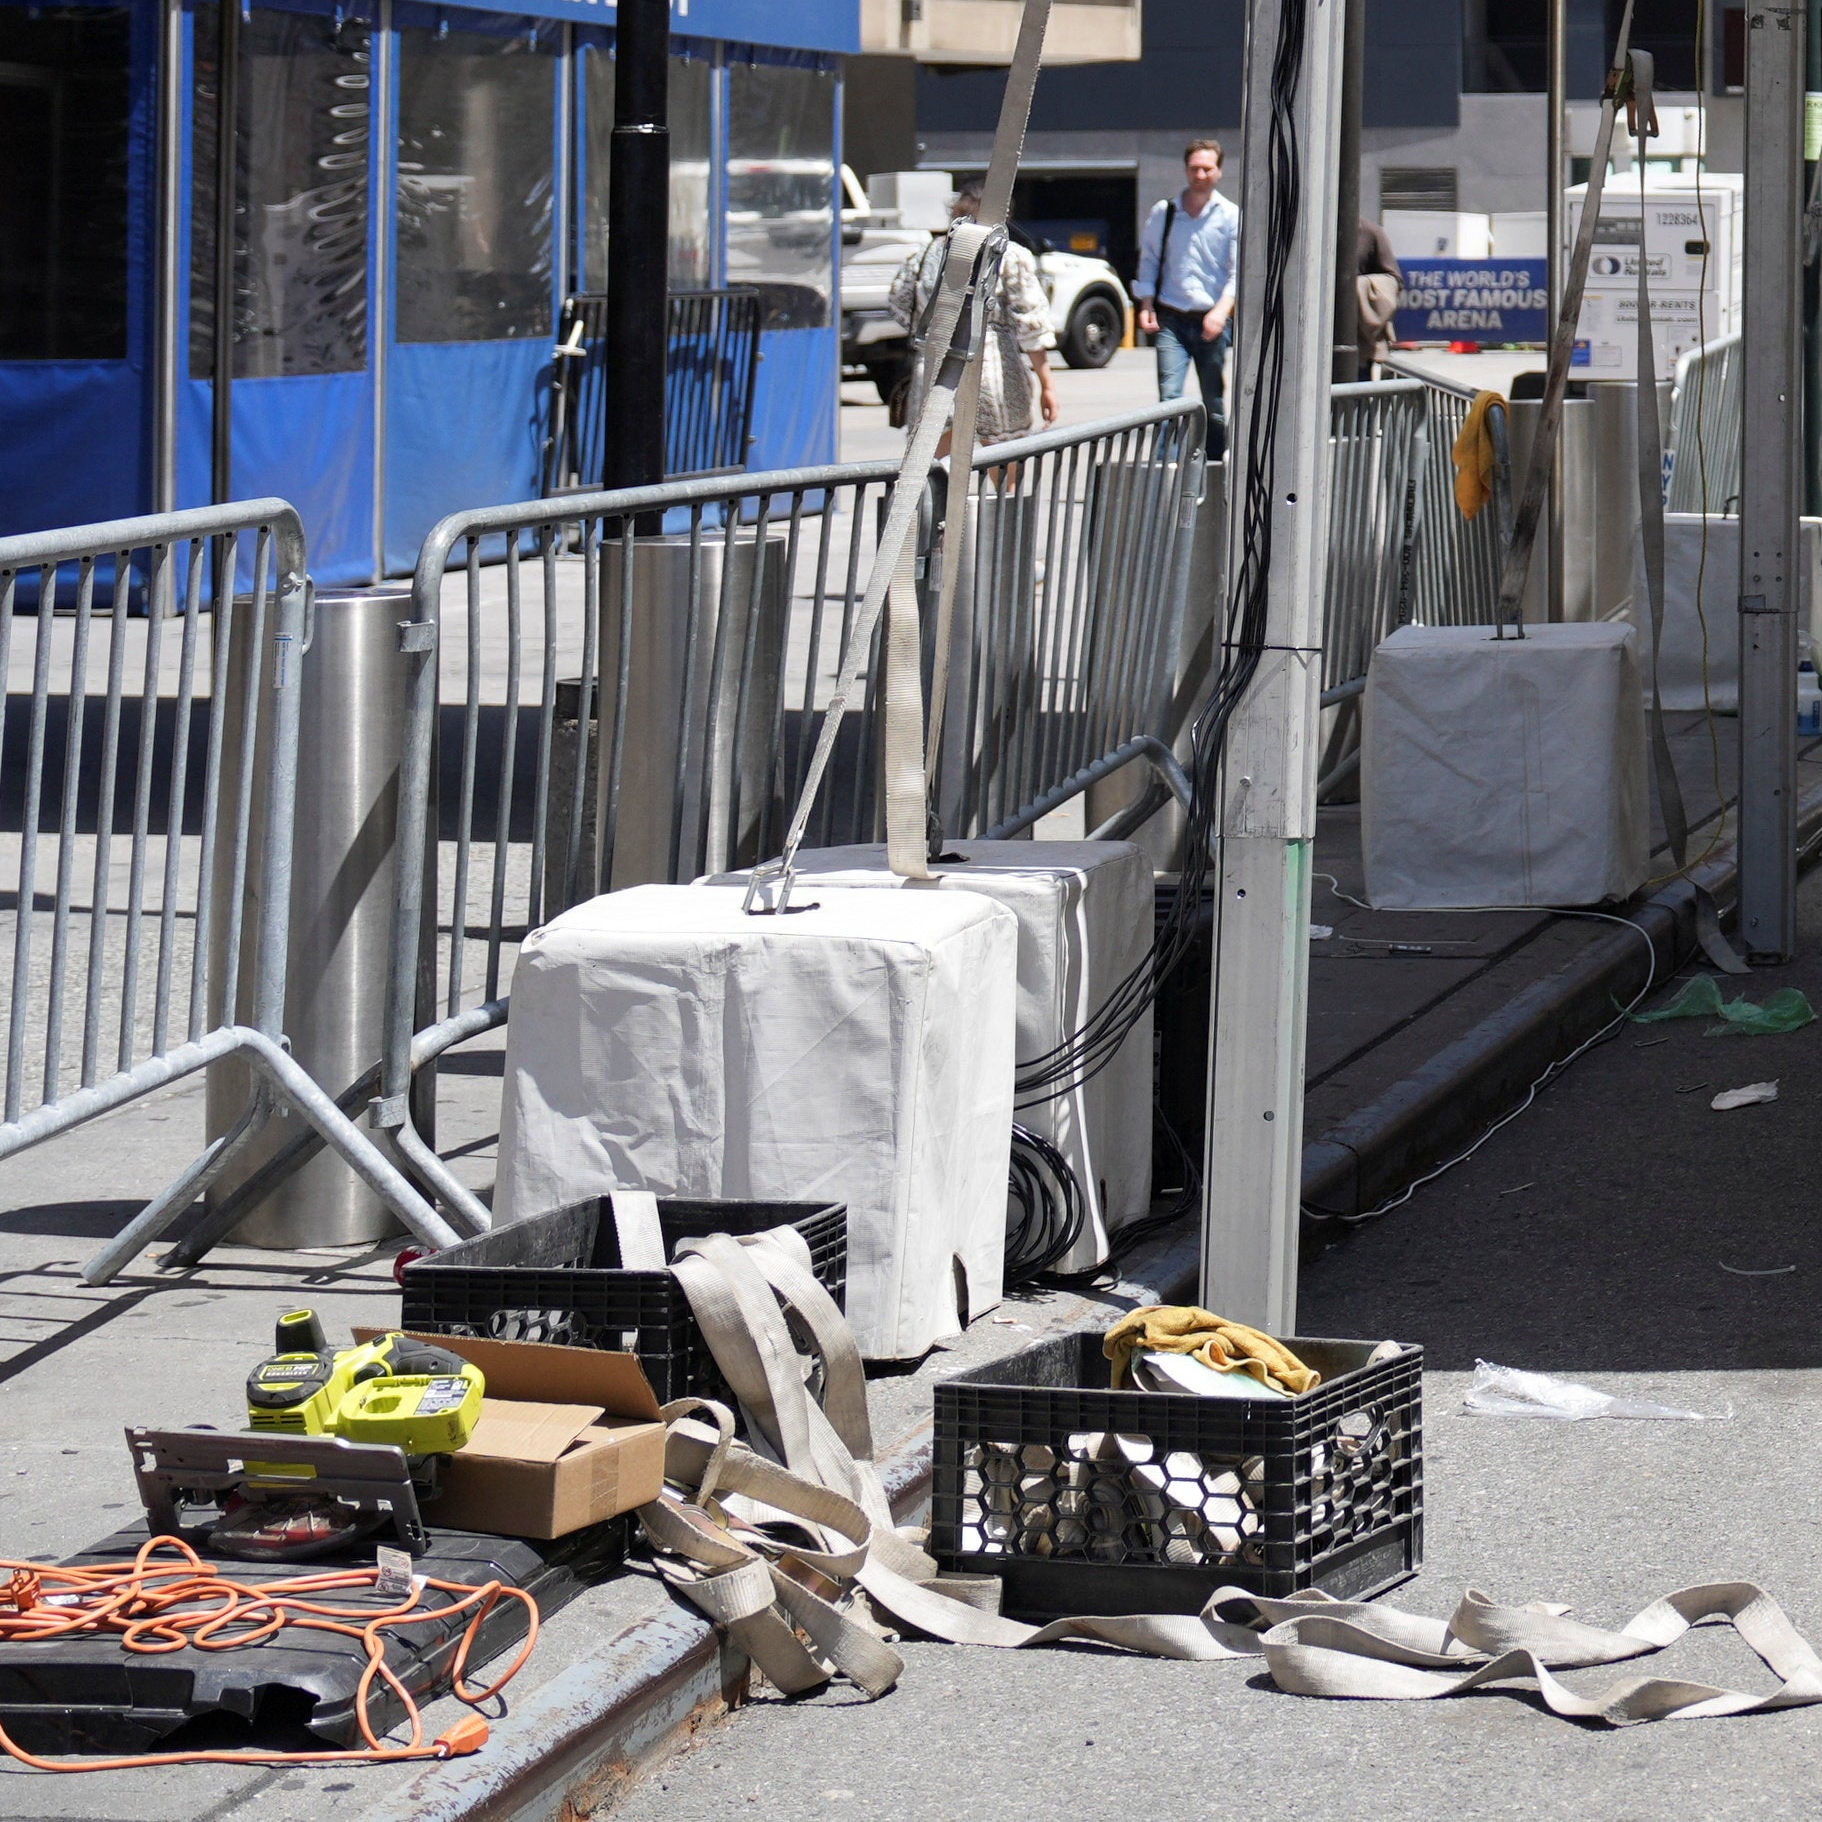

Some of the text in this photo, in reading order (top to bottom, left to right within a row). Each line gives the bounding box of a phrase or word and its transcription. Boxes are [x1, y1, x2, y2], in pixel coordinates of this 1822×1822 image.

[1407, 270, 1530, 289] THE WORLD'S
[1453, 289, 1548, 310] FAMOUS
[1426, 310, 1503, 329] ARENA
